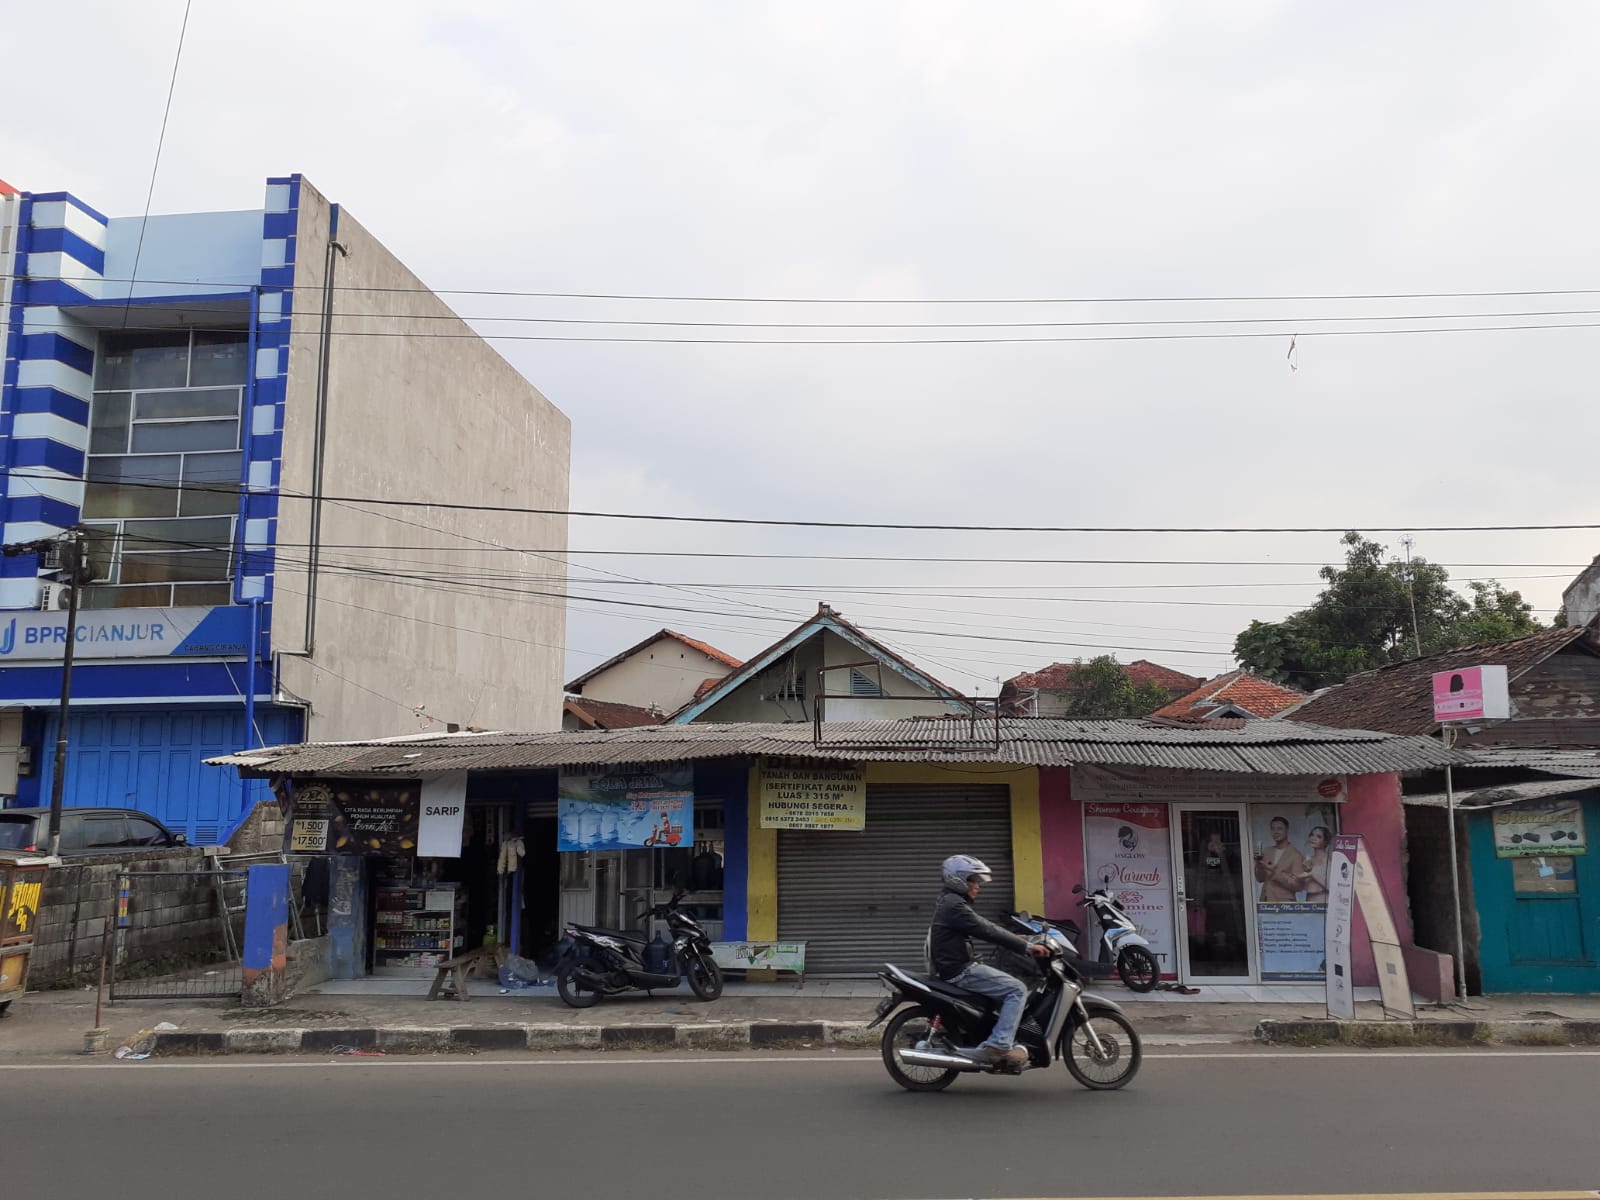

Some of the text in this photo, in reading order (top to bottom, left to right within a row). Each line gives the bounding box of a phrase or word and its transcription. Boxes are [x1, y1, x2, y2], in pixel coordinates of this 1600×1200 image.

[25, 623, 164, 644] BPR CIANJUR
[762, 771, 863, 781] TANAH DAN BANGUNAN
[765, 782, 857, 793] (SERTIFIKAT AMAN)
[302, 789, 326, 801] 234
[777, 791, 802, 799] LUAS
[813, 792, 830, 800] 315
[425, 806, 460, 816] SARIP
[768, 801, 809, 810] HUBUNGI
[812, 803, 848, 811] SEGERA
